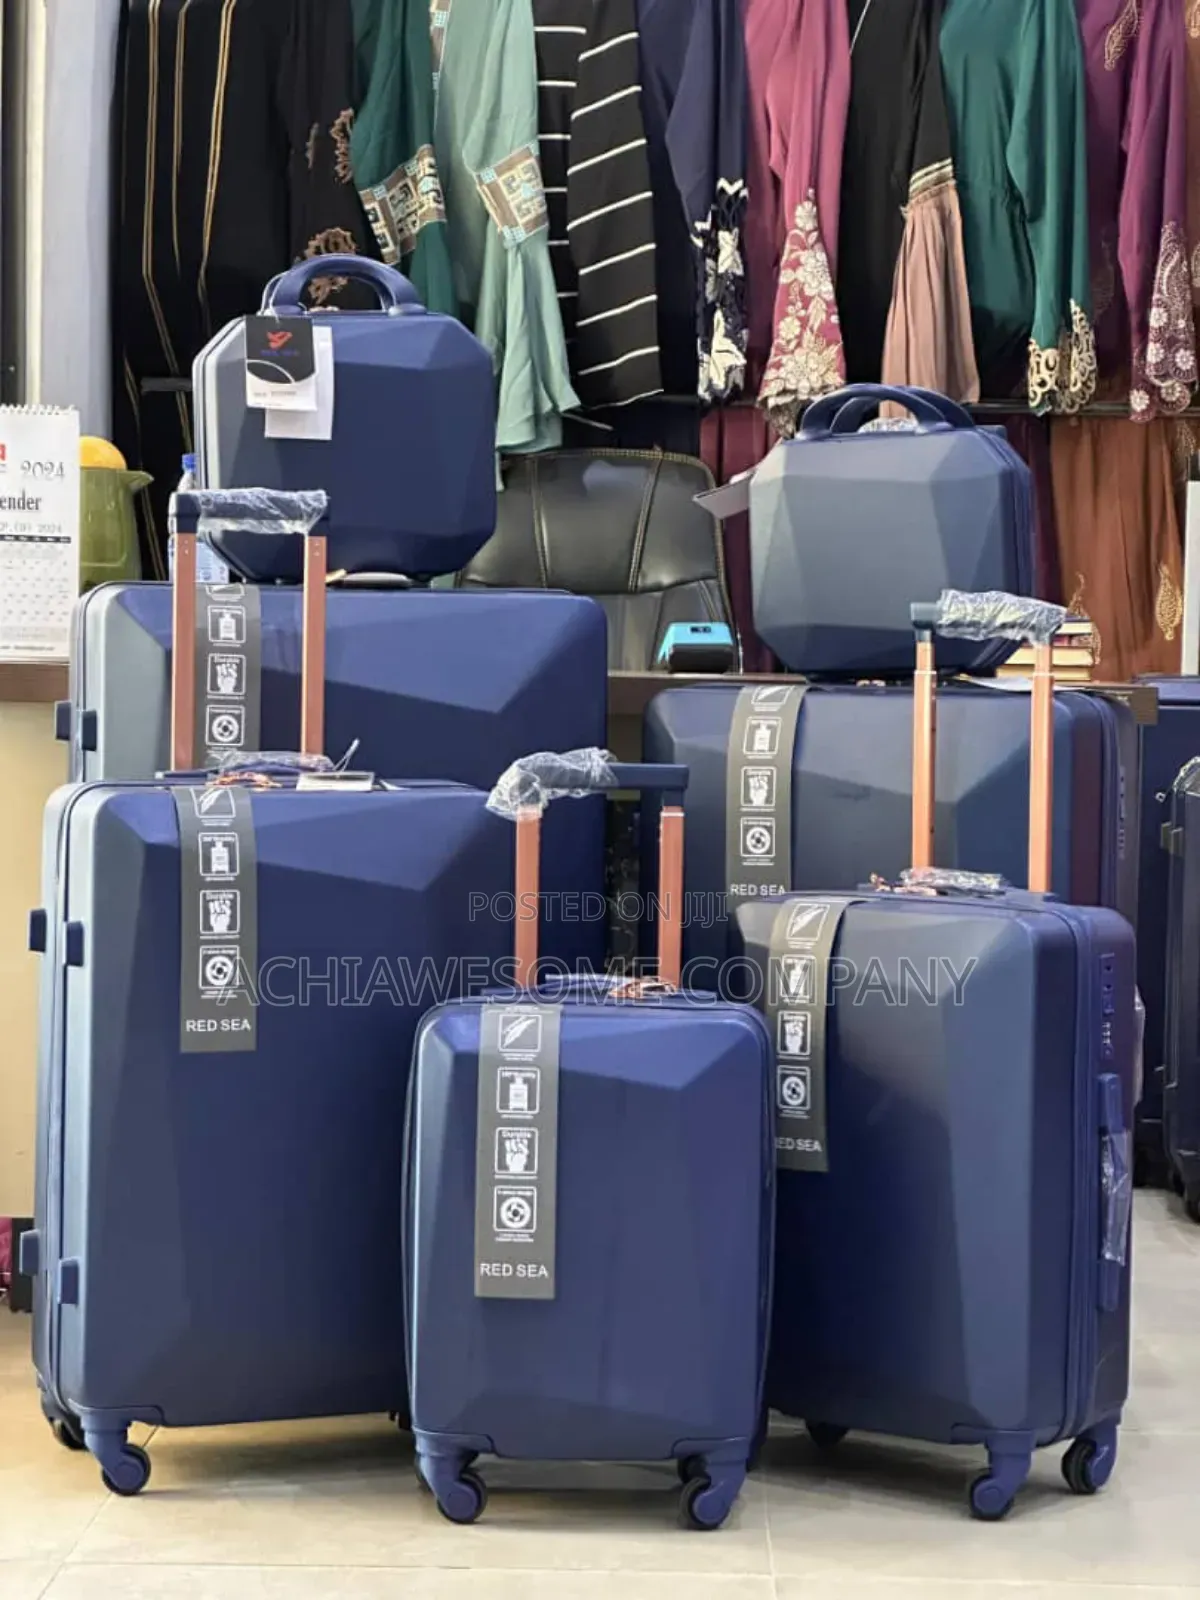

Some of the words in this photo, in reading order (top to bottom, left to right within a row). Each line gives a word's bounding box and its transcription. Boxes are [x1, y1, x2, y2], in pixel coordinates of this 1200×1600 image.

[20, 460, 65, 482] 2024
[730, 883, 758, 896] RED
[759, 884, 786, 896] SEA
[185, 1019, 217, 1032] RED
[220, 1019, 251, 1031] SEA
[775, 1137, 795, 1150] ED
[797, 1139, 822, 1152] SEA
[480, 1263, 513, 1277] RED
[516, 1264, 549, 1278] SEA
